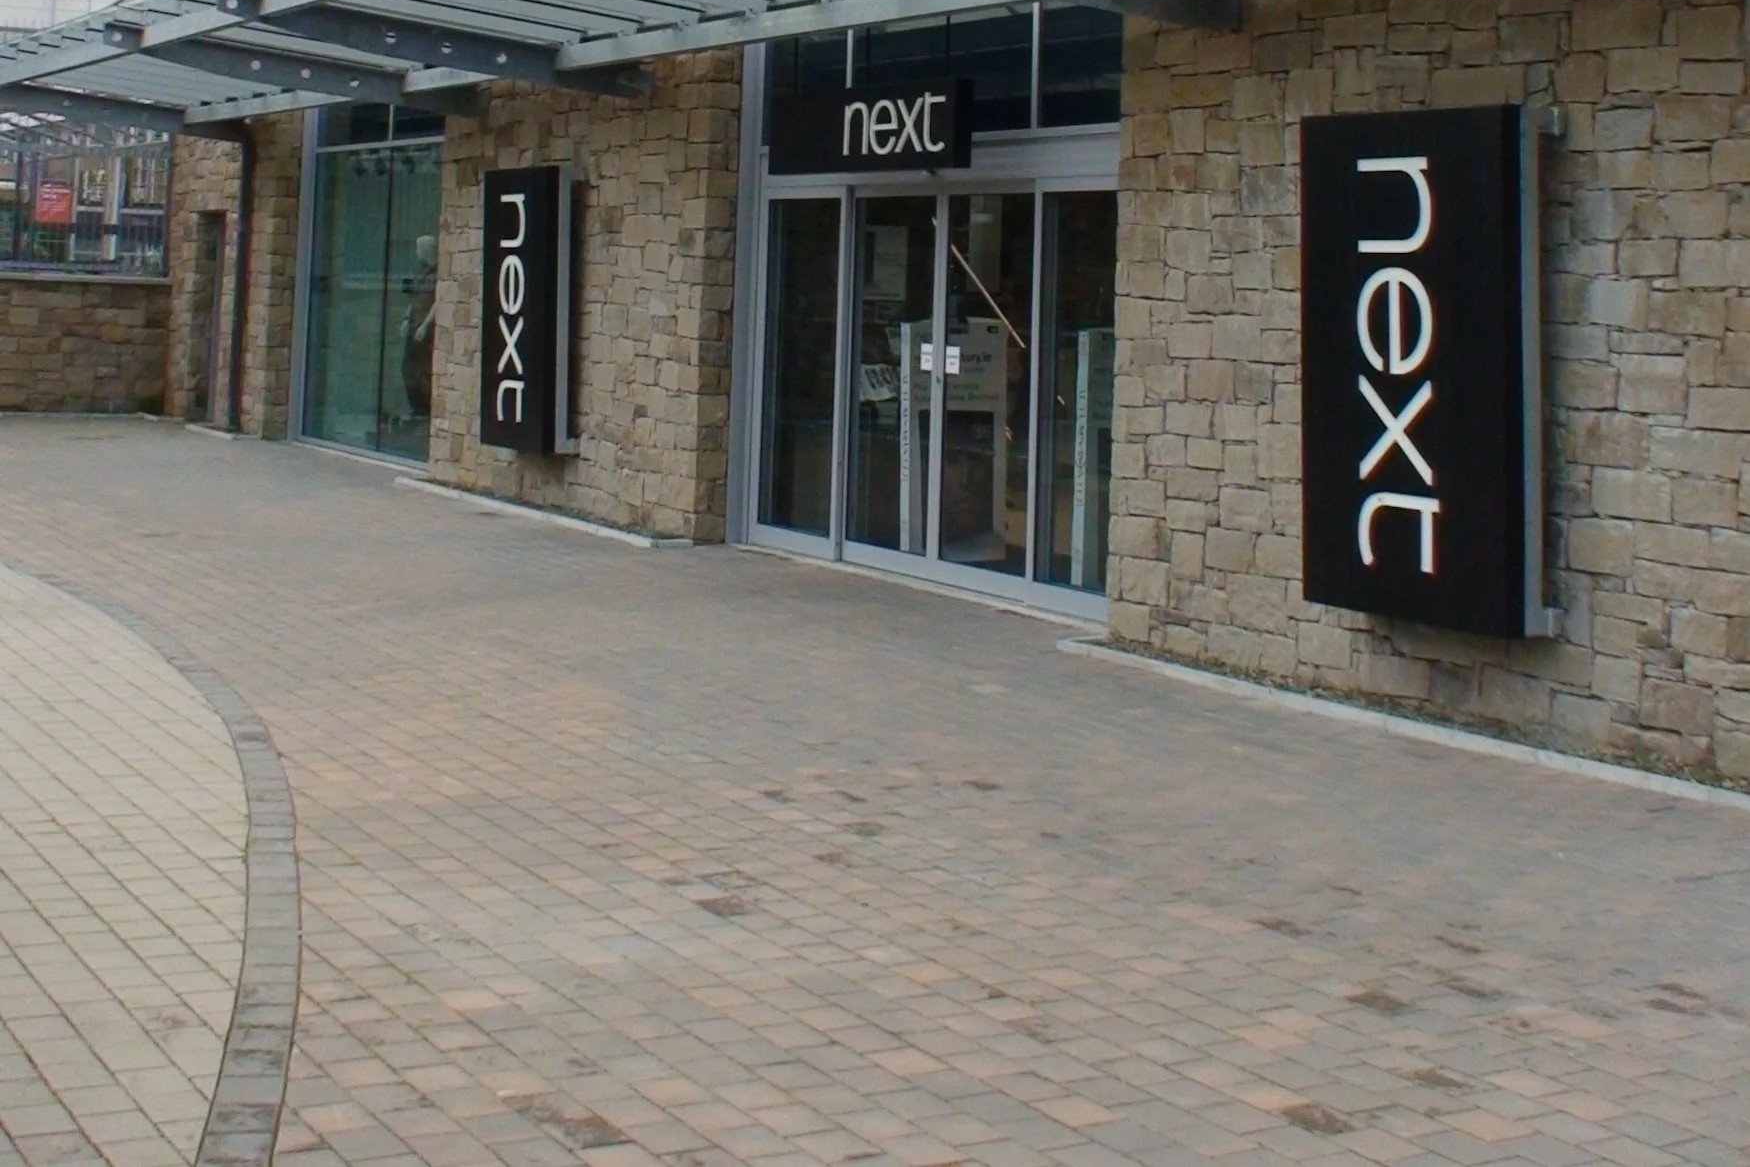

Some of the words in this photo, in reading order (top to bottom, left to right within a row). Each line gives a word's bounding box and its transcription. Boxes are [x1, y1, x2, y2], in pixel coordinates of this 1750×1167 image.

[843, 92, 946, 156] next
[497, 192, 526, 424] next
[1357, 155, 1441, 575] next
